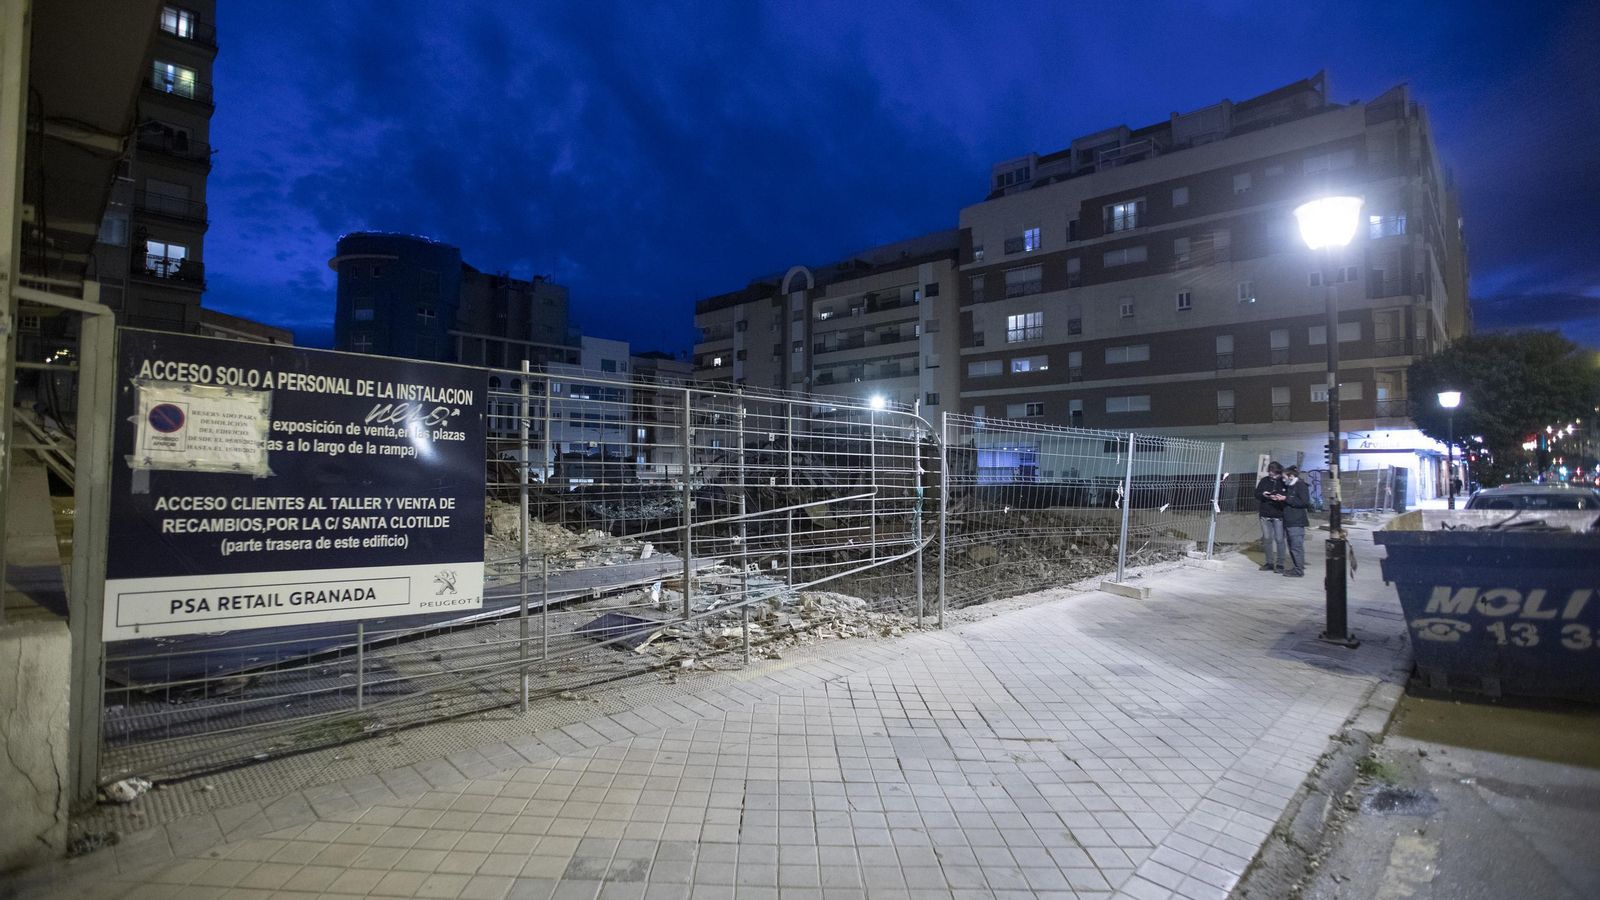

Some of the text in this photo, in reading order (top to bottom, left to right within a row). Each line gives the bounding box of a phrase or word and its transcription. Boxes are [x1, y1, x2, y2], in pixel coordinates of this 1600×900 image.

[139, 359, 473, 406] ACCESO SOLO A PERSONAL DE LA INSTALACION
[273, 419, 343, 435] exposición
[346, 422, 360, 434] de
[433, 427, 465, 441] plazas
[286, 441, 295, 452] a
[298, 438, 310, 453] lo
[314, 439, 345, 456] largo
[348, 441, 363, 453] de
[367, 442, 376, 454] la
[380, 444, 418, 459] rampa)
[154, 496, 456, 511] ACCESO CLIENTES AL TALLER Y VENTA DE
[162, 516, 451, 534] RECAMBIOS,POR LA C/ SANTA CLOTILDE
[220, 534, 409, 556] (parte trasera de este edificio)
[170, 587, 377, 615] PSA RETAIL GRANADA
[419, 597, 473, 608] PEUGEOT
[1486, 621, 1600, 650] 13 3
